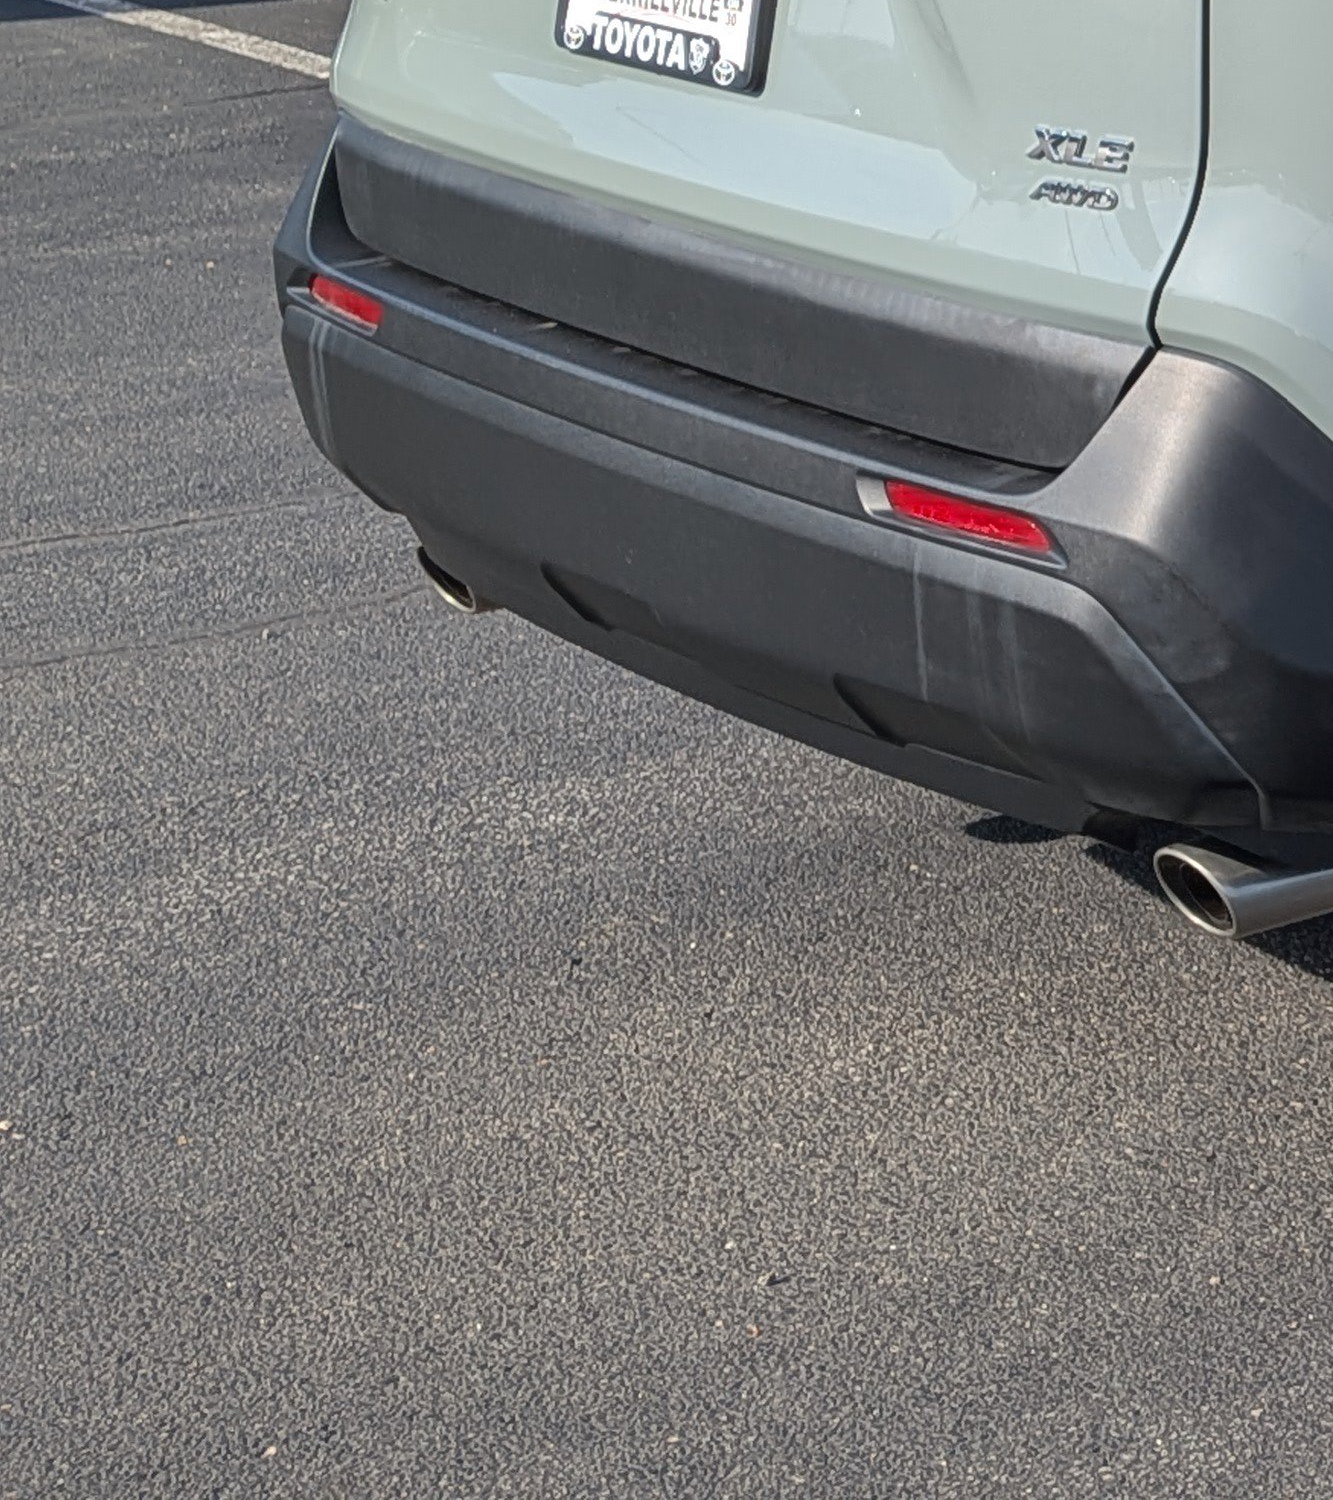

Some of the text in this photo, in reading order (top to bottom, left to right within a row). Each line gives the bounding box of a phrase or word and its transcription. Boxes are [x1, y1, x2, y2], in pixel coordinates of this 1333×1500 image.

[592, 16, 688, 71] TOYOTA
[1026, 124, 1135, 174] XLE
[1029, 178, 1119, 211] AWD
